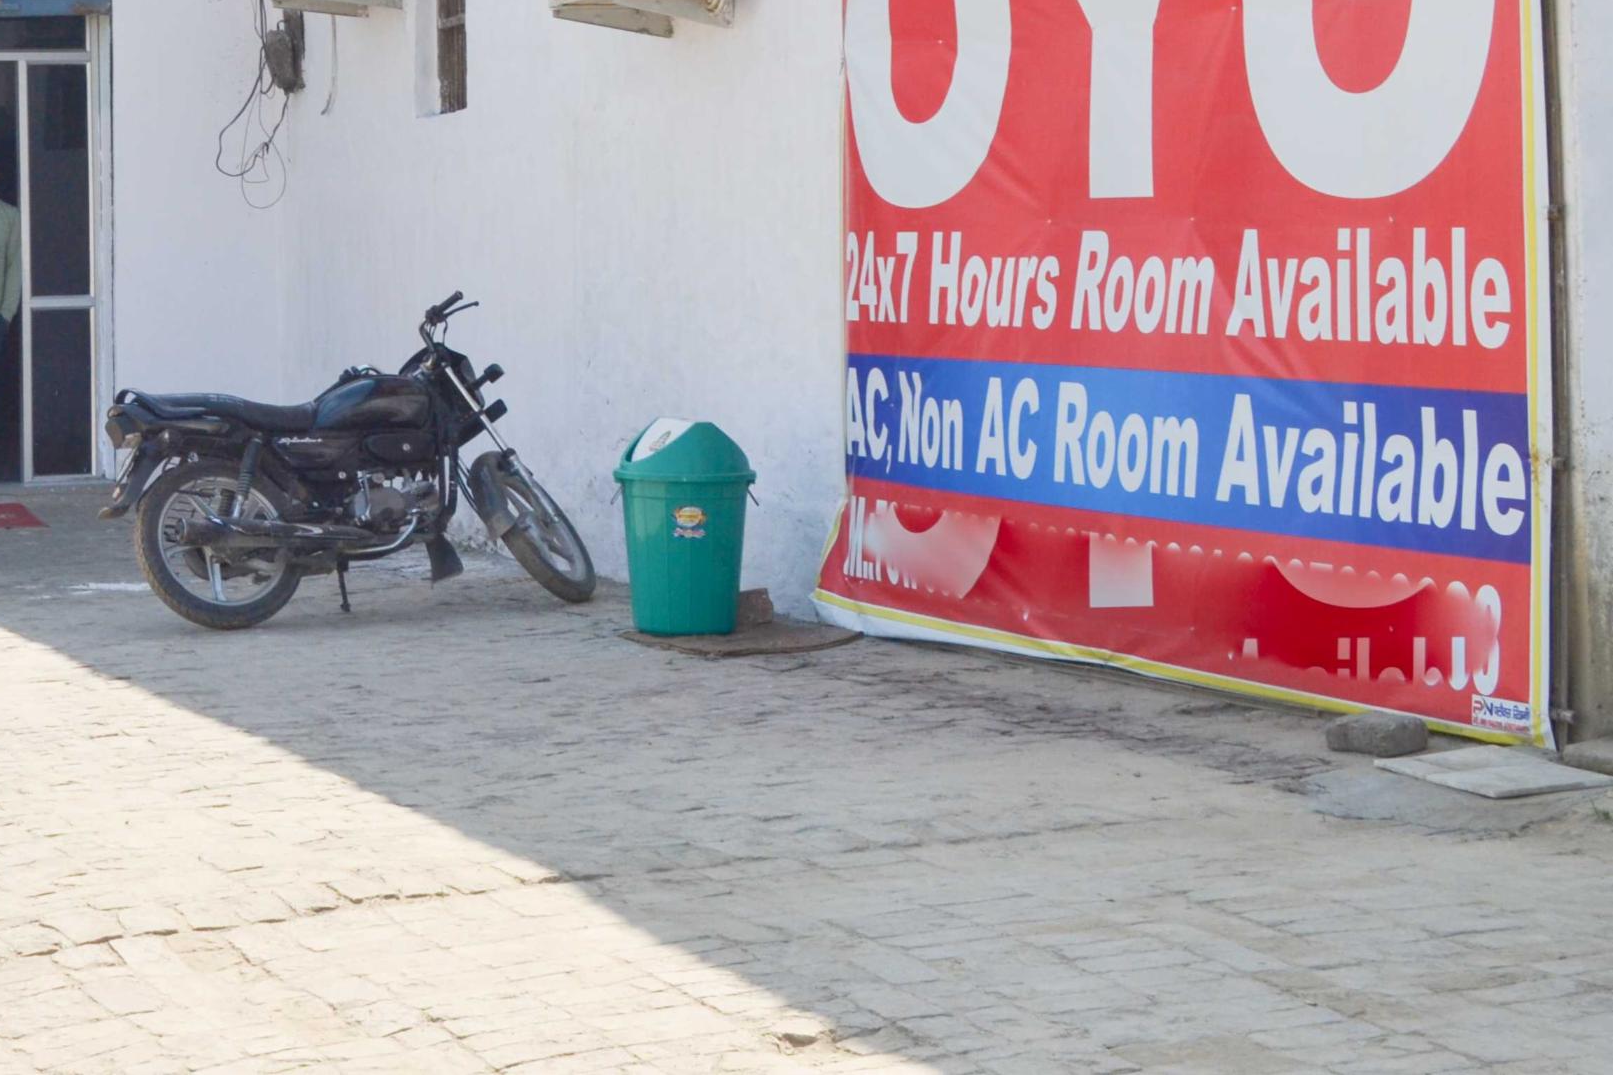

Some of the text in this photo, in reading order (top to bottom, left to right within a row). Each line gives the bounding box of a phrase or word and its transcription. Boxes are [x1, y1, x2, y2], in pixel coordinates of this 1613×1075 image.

[845, 226, 1512, 350] 24x7 Hours Room Available
[897, 370, 964, 472] Non
[975, 375, 1041, 481] AC
[1053, 380, 1199, 499] Room
[1216, 392, 1528, 538] Available
